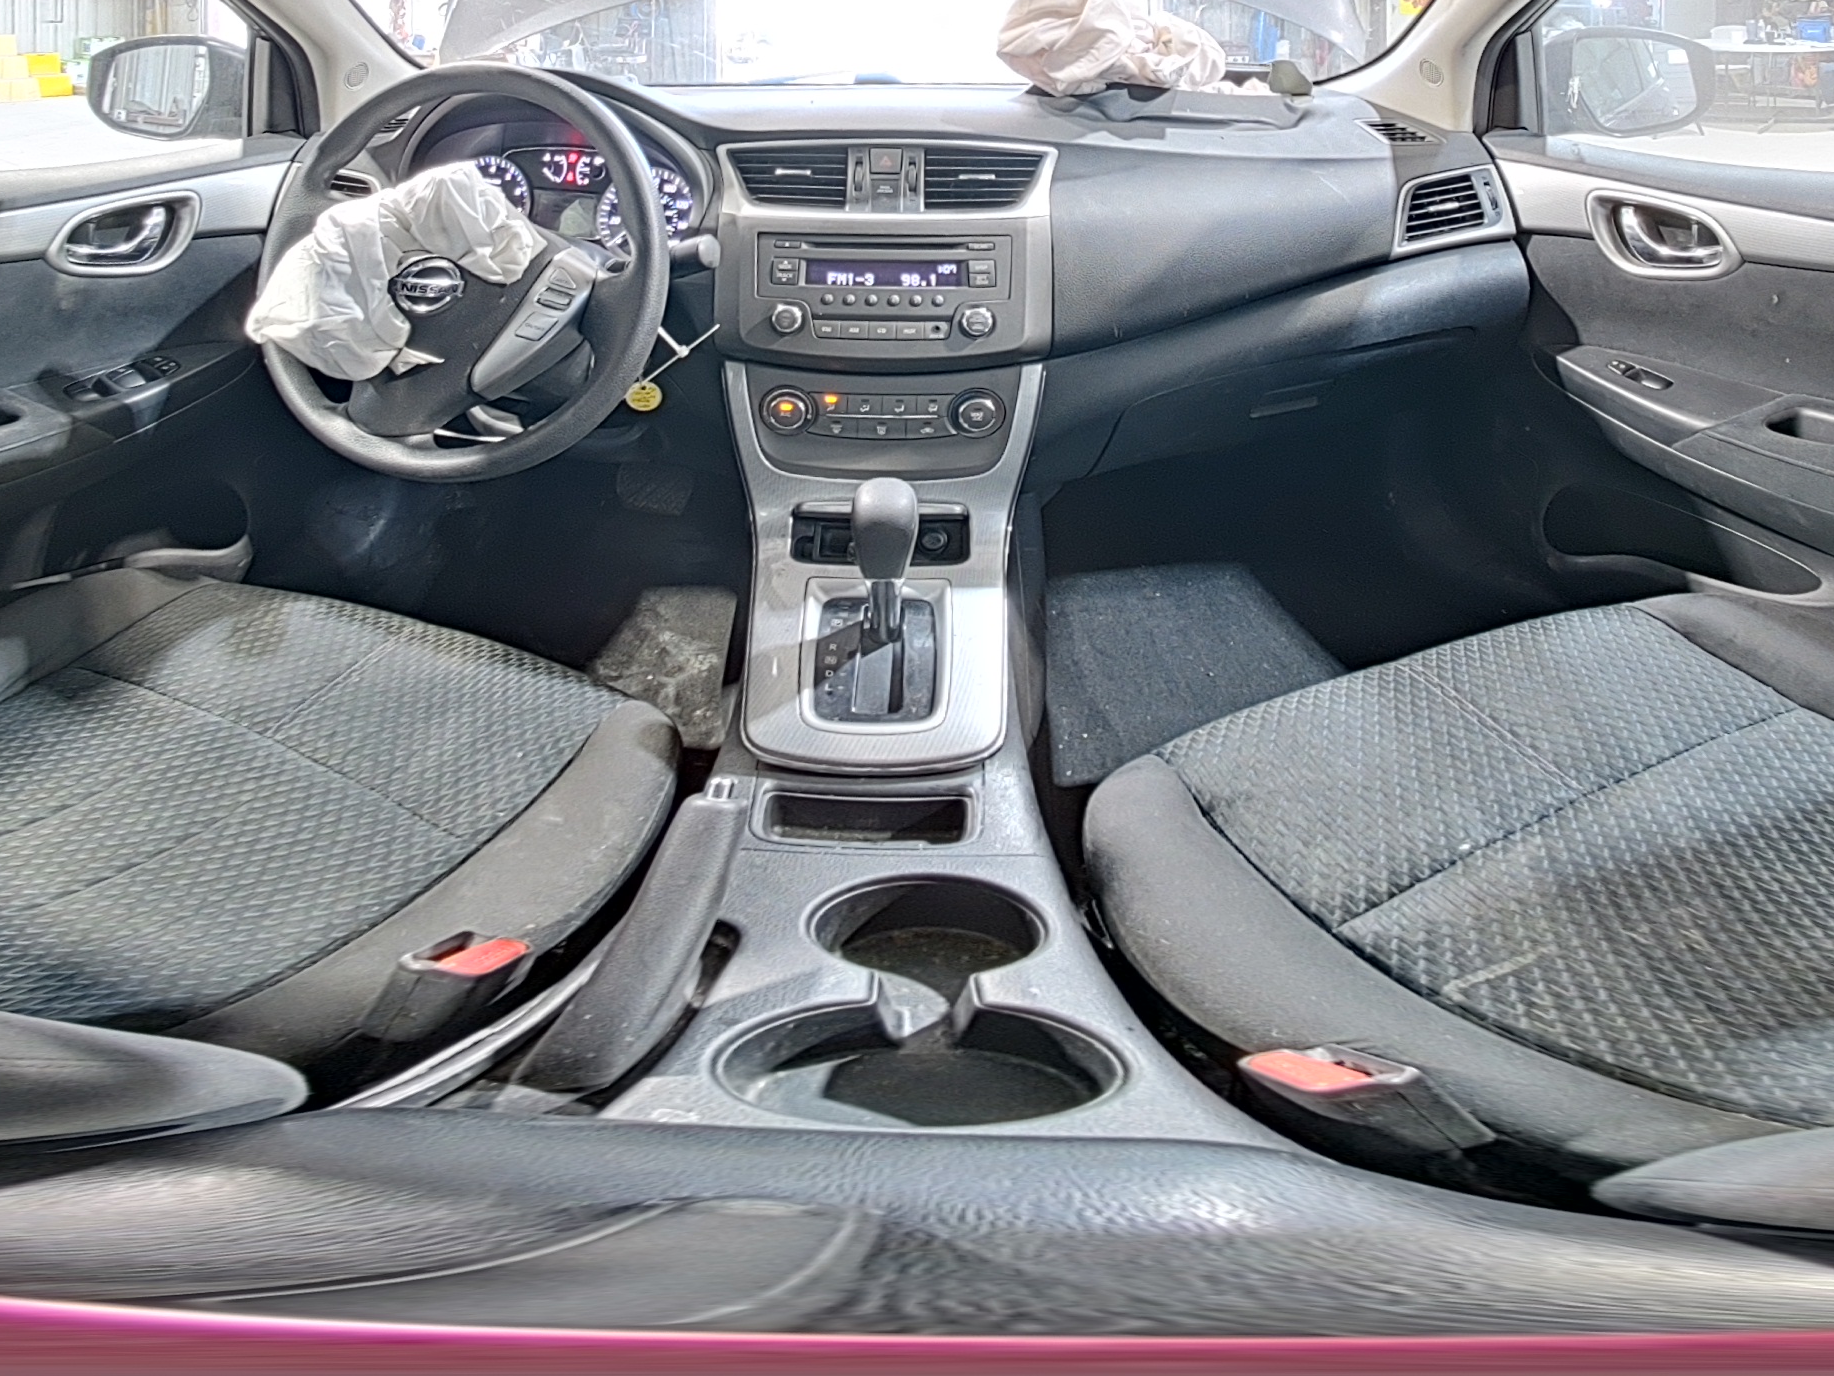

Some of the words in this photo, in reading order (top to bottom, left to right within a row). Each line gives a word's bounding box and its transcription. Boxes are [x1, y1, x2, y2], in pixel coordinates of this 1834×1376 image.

[827, 271, 875, 286] FM1-3
[900, 273, 937, 287] 98.1
[401, 283, 458, 294] NISSAN
